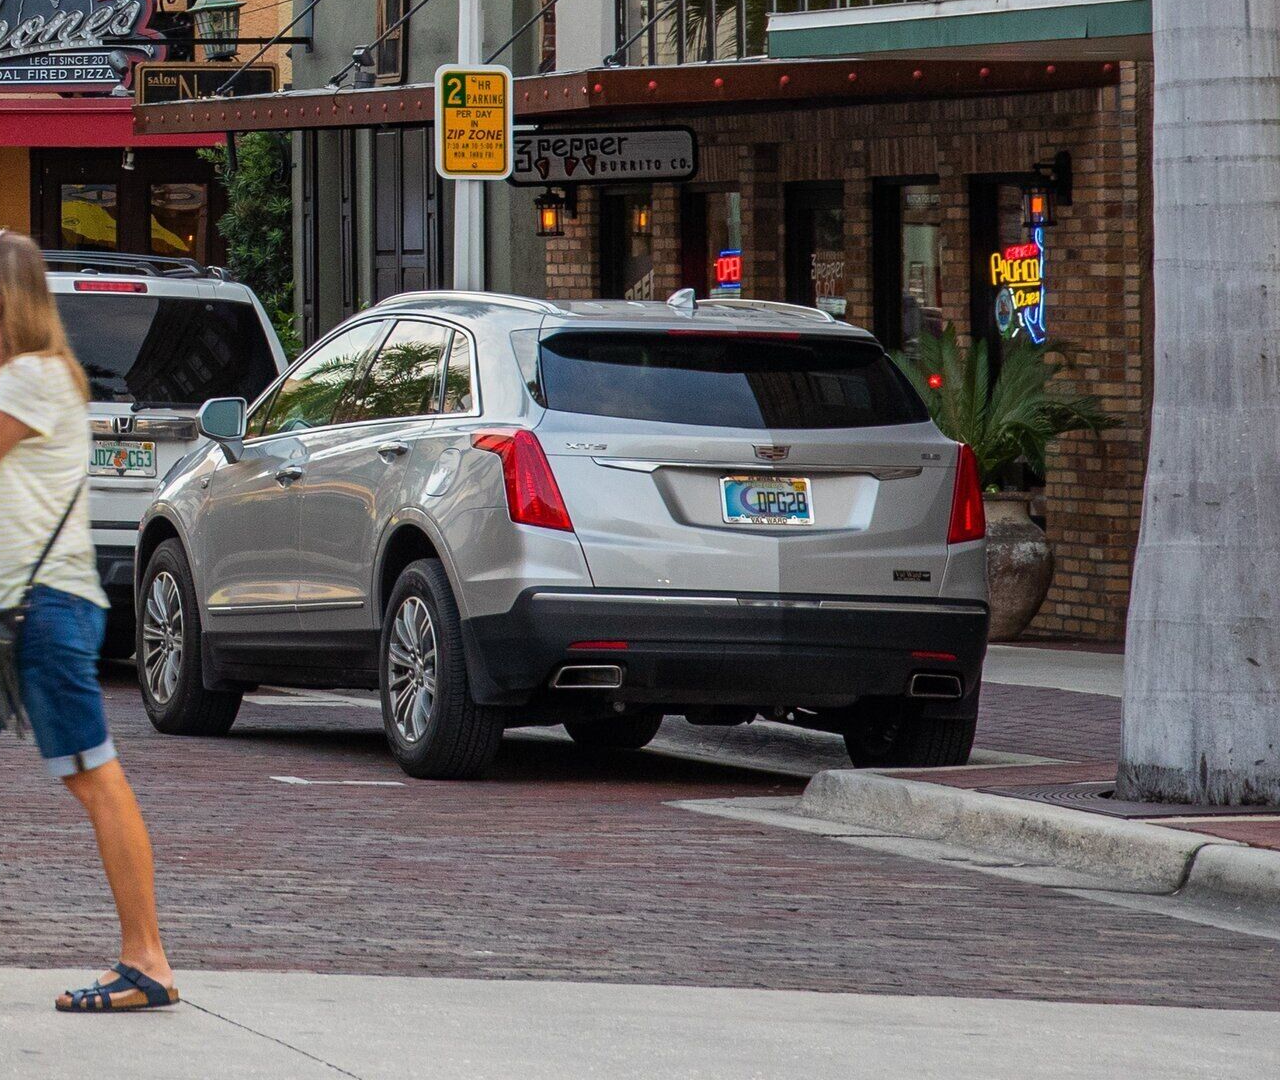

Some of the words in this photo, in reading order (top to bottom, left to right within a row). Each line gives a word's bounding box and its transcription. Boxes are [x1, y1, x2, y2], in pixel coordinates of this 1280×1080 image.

[29, 56, 57, 66] LEGIT
[59, 55, 89, 65] SINCE
[27, 69, 68, 81] FIRED
[74, 69, 115, 80] PIZZA
[447, 77, 462, 105] 2
[478, 81, 491, 90] HR
[467, 94, 503, 104] PARKING
[456, 110, 472, 118] PER
[476, 110, 492, 118] DAY
[447, 129, 465, 140] ZIP
[469, 129, 503, 140] ZONE
[537, 136, 628, 160] pepper
[600, 159, 661, 172] BURRITO
[670, 158, 691, 170] CO.
[91, 449, 113, 466] JDZ
[128, 451, 151, 467] C63
